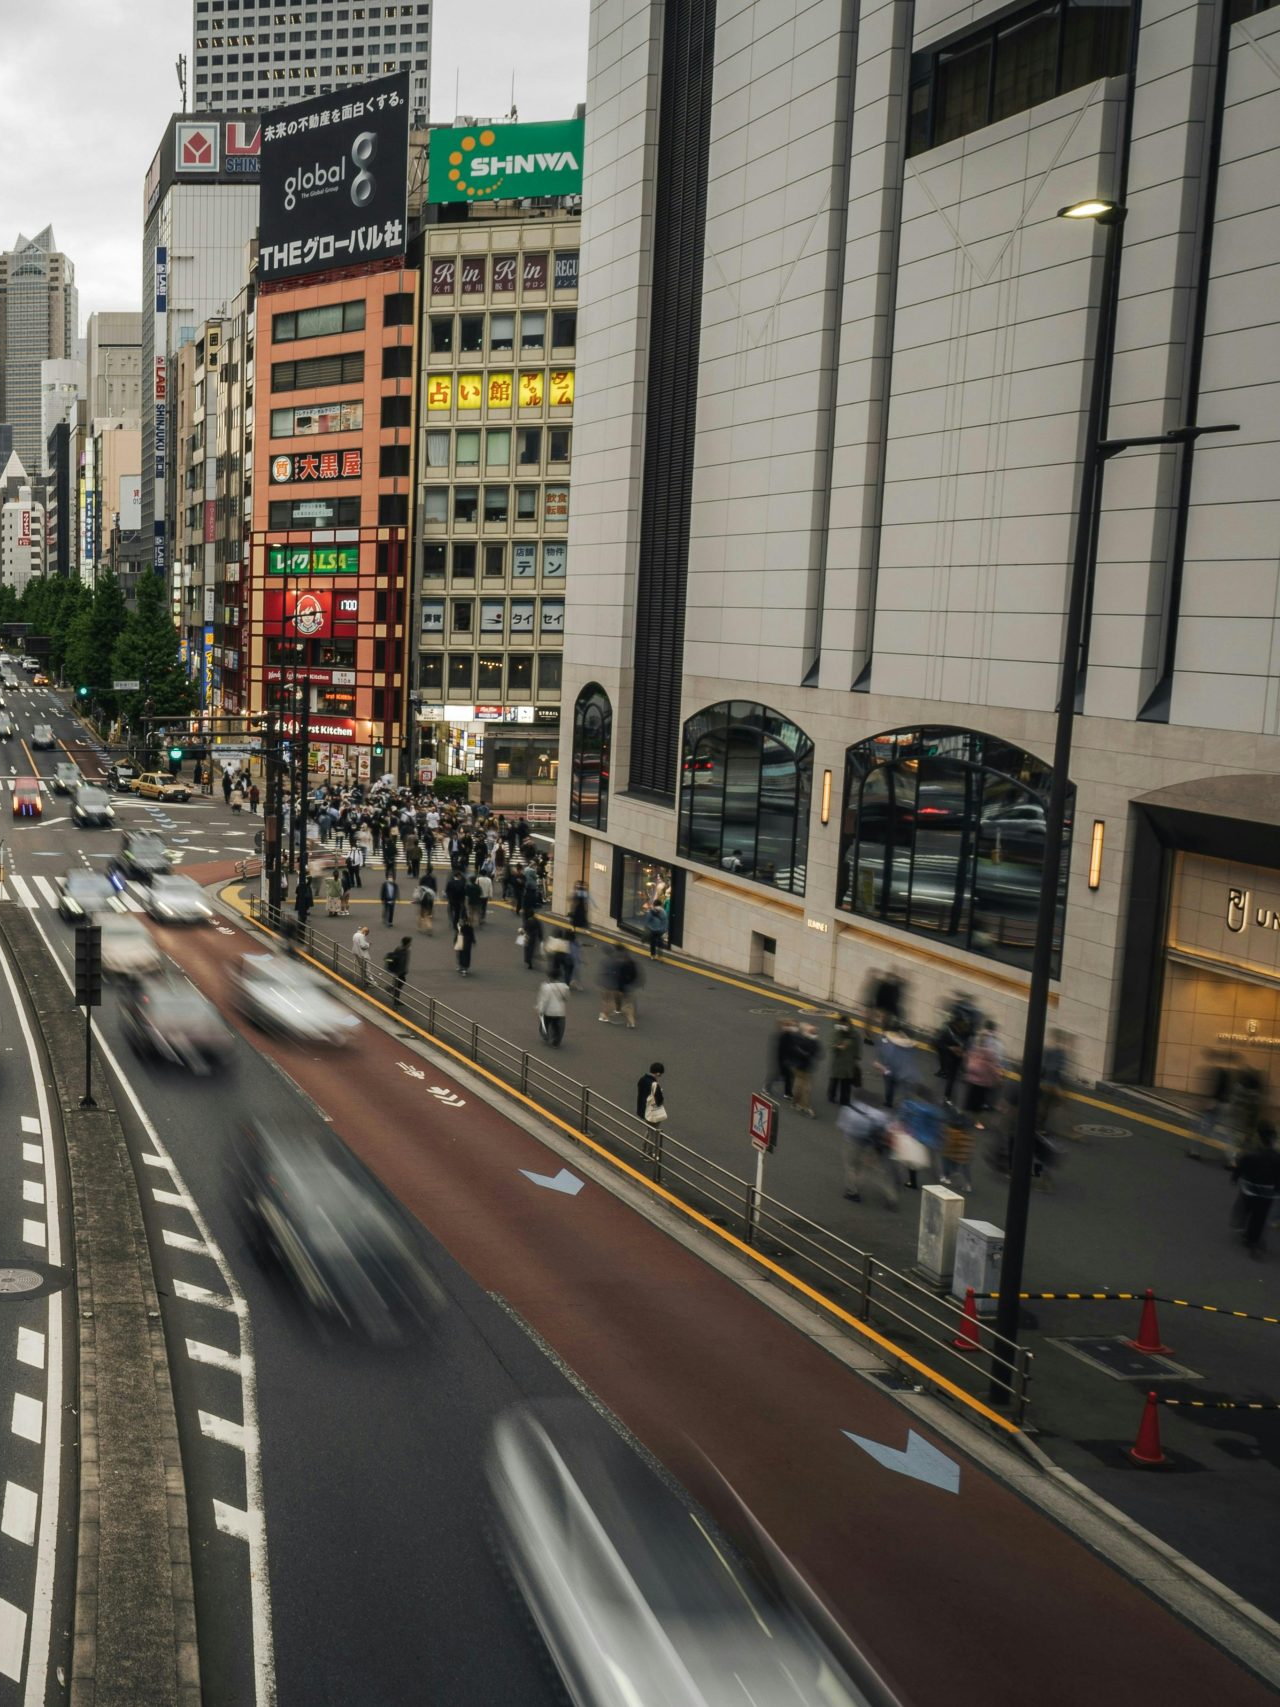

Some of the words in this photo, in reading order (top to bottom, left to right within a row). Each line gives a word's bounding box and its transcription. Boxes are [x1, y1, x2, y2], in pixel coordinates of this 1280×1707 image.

[264, 91, 404, 142] 未来の不動産を面白くする。
[284, 155, 346, 211] global
[310, 189, 324, 197] Global
[325, 186, 339, 195] Group
[260, 219, 403, 271] THEグローバル社
[155, 366, 166, 400] LABI
[429, 380, 511, 405] 占い館
[155, 403, 166, 451] SHINJUKU
[275, 460, 289, 478] 質
[300, 451, 361, 480] 大黒屋
[320, 725, 353, 736] Kitchen
